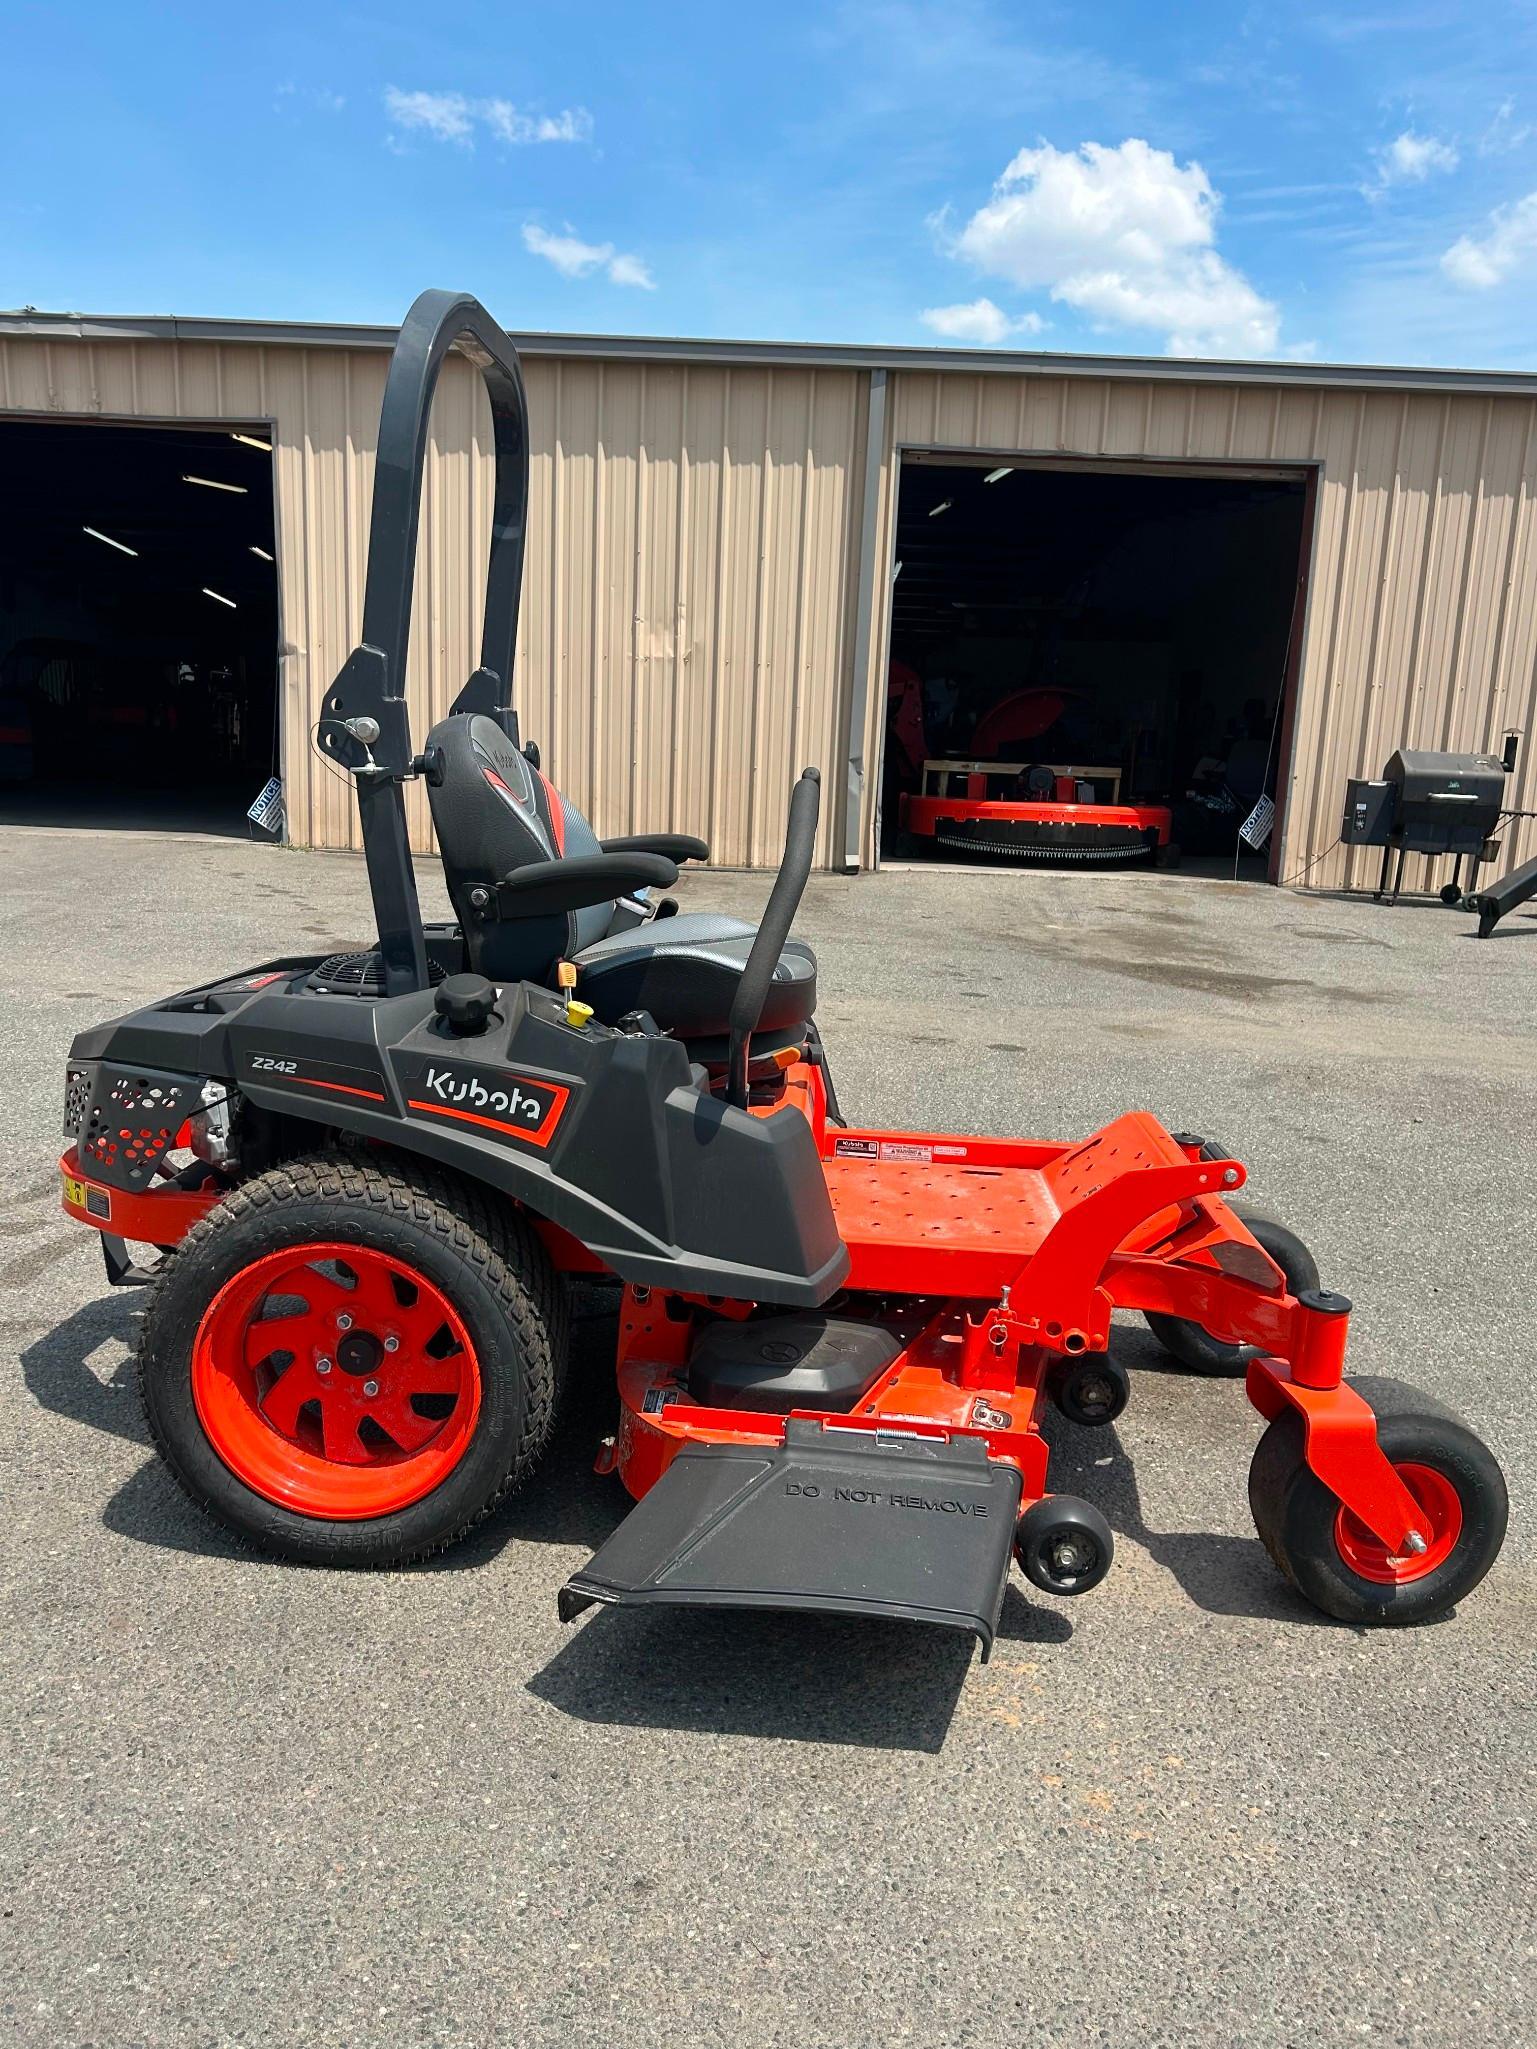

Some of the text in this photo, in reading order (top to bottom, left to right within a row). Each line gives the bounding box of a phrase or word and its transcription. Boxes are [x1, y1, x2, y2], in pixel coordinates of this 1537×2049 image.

[250, 780, 280, 819] NOTICE
[1241, 798, 1270, 836] NOTICE
[251, 1056, 298, 1075] Z242
[426, 1068, 542, 1120] Kubota
[785, 1482, 989, 1518] DO NOT REMOVE
